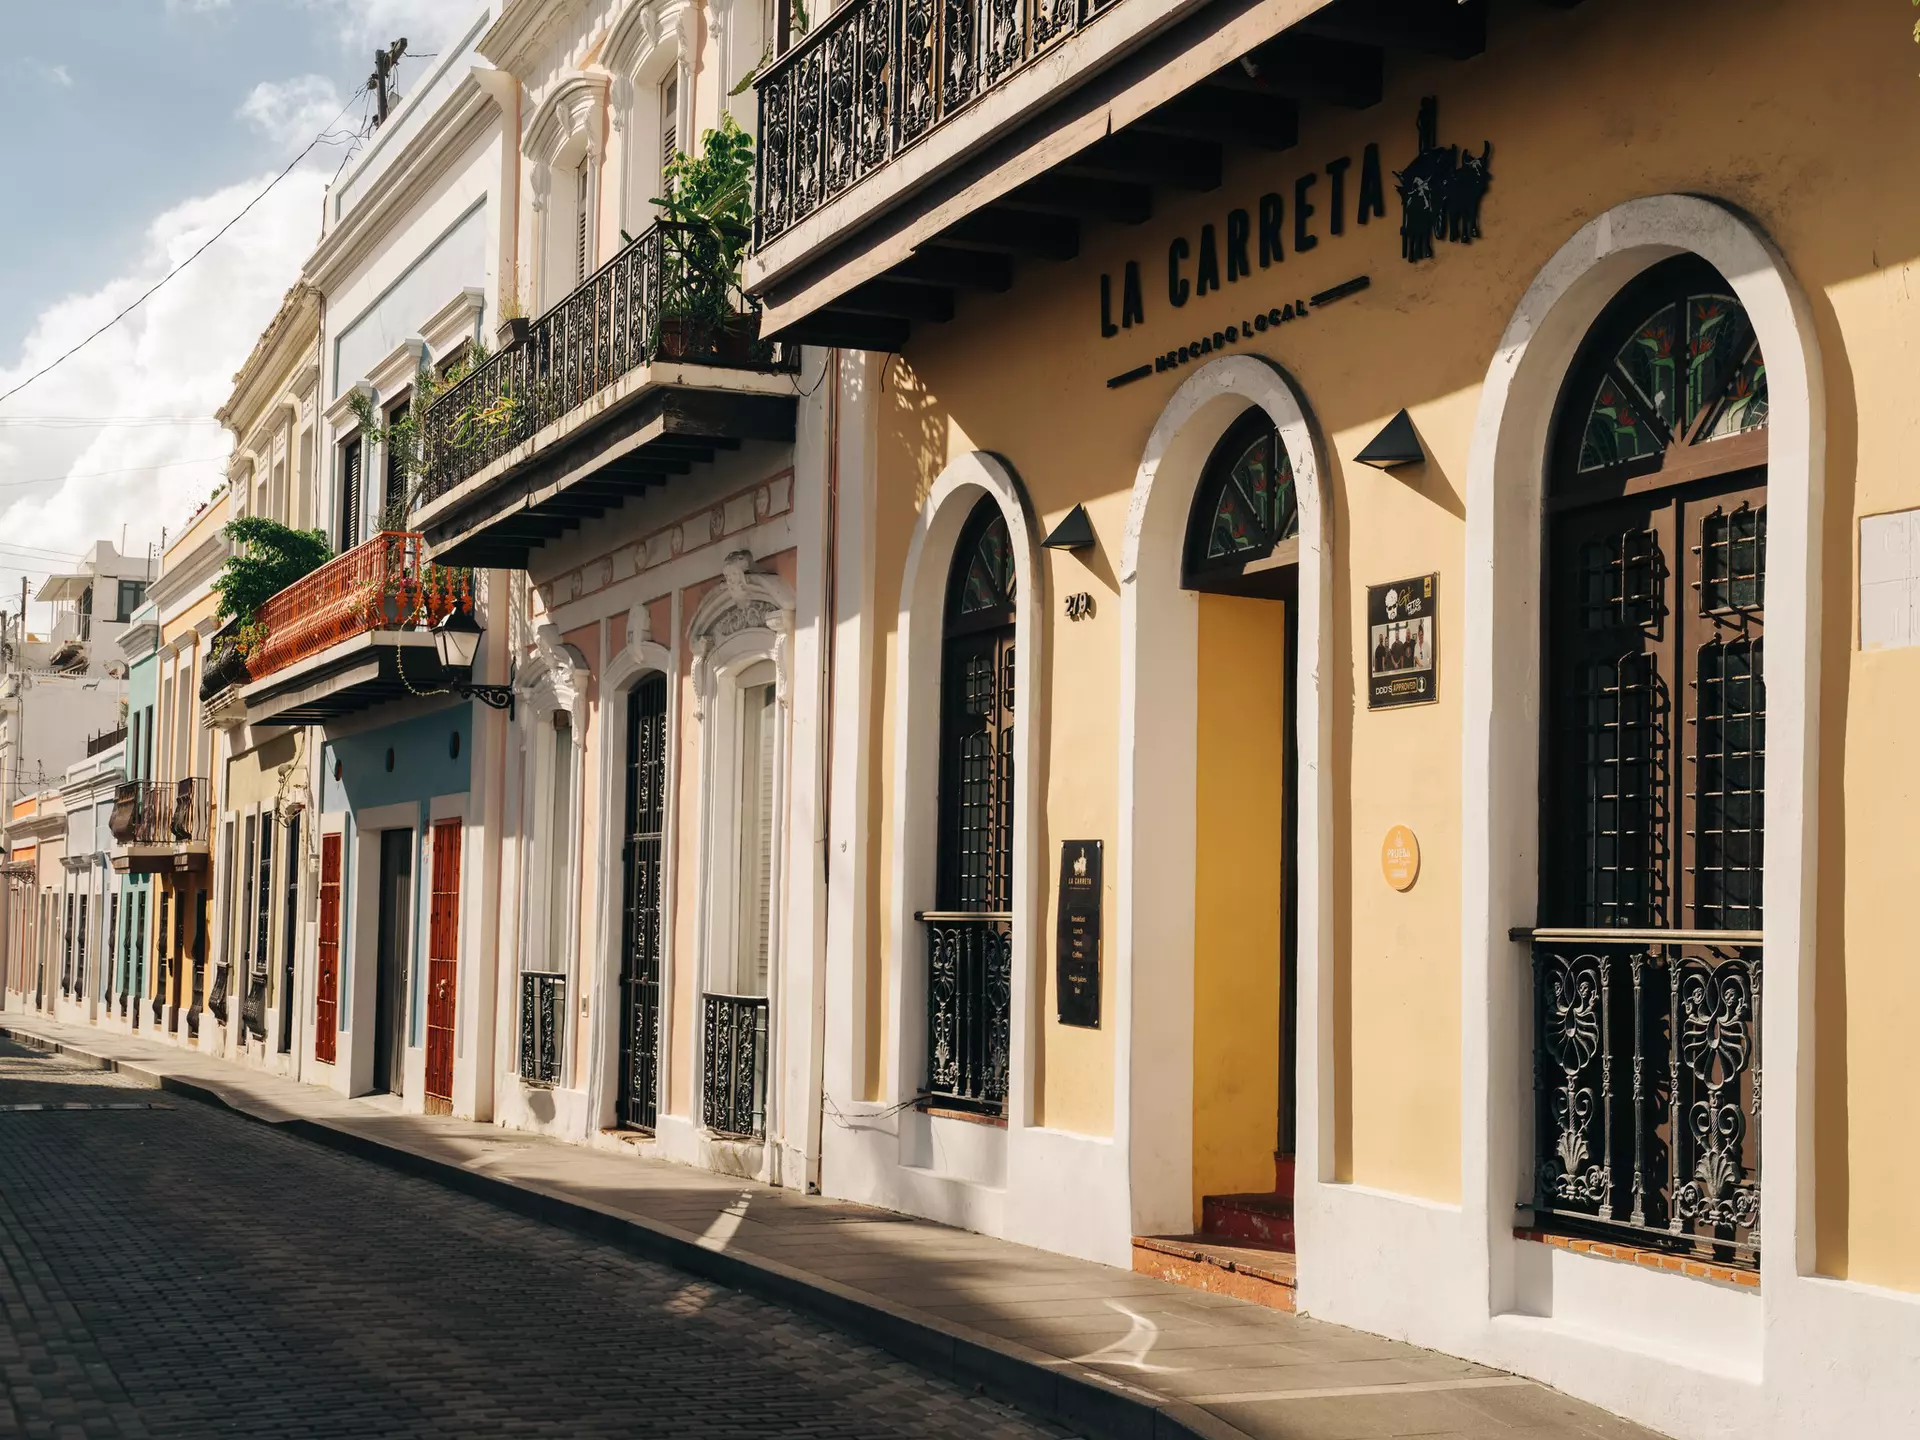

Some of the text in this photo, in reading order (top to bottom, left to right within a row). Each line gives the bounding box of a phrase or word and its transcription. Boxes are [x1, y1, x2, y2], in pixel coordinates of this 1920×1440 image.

[1101, 142, 1386, 339] LA CARRETA
[1155, 299, 1309, 373] MERCADO LOCAL
[1393, 681, 1417, 692] APPROVED
